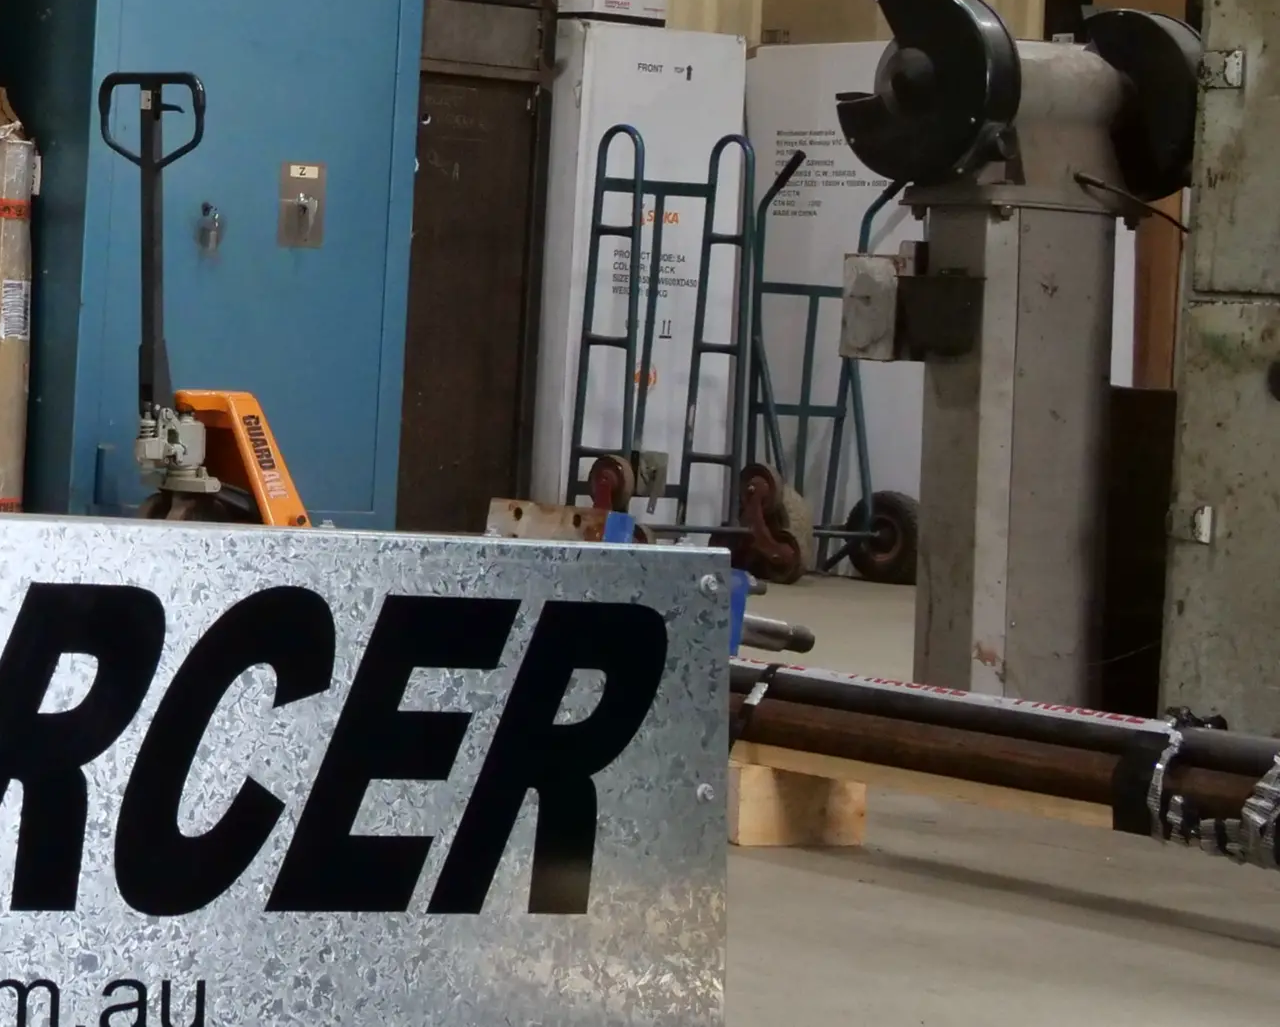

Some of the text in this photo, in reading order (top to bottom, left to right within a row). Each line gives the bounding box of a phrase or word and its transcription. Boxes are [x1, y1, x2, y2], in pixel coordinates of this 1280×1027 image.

[637, 62, 663, 73] FRONT
[646, 210, 680, 224] SKA
[613, 249, 651, 260] PROCT
[612, 261, 647, 273] COLR:
